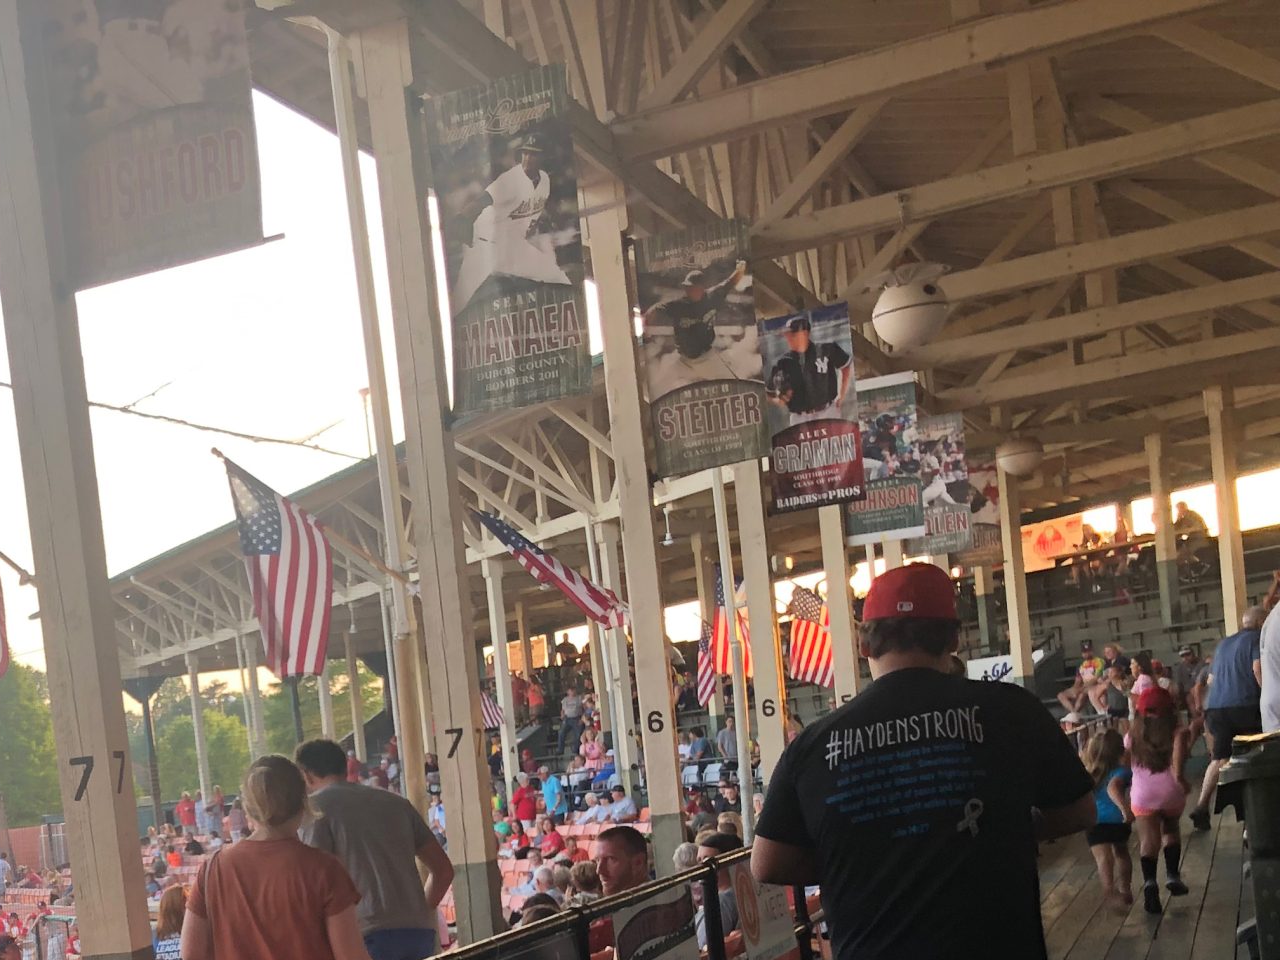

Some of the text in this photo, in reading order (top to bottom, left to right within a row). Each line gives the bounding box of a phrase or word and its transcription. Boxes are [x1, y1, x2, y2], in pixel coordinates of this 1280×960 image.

[78, 128, 247, 224] USHFORD
[493, 291, 537, 311] SEAN
[460, 300, 582, 369] MANAEA
[477, 354, 566, 381] DUBOIS COUNTY
[485, 375, 535, 391] BOMBERS
[538, 369, 559, 381] 2011
[683, 384, 729, 398] MITCH
[658, 391, 762, 441] STETTER
[799, 428, 828, 440] ALEX
[773, 433, 857, 474] GRAMAN
[776, 492, 818, 508] RAIDERS
[828, 485, 861, 500] PROS
[848, 484, 918, 513] JOHNSON
[647, 710, 664, 733] 6
[762, 699, 776, 717] 6
[444, 728, 463, 759] 7
[825, 705, 984, 771] #HAYDENSTRONG
[69, 755, 94, 801] 7
[113, 750, 125, 794] 7
